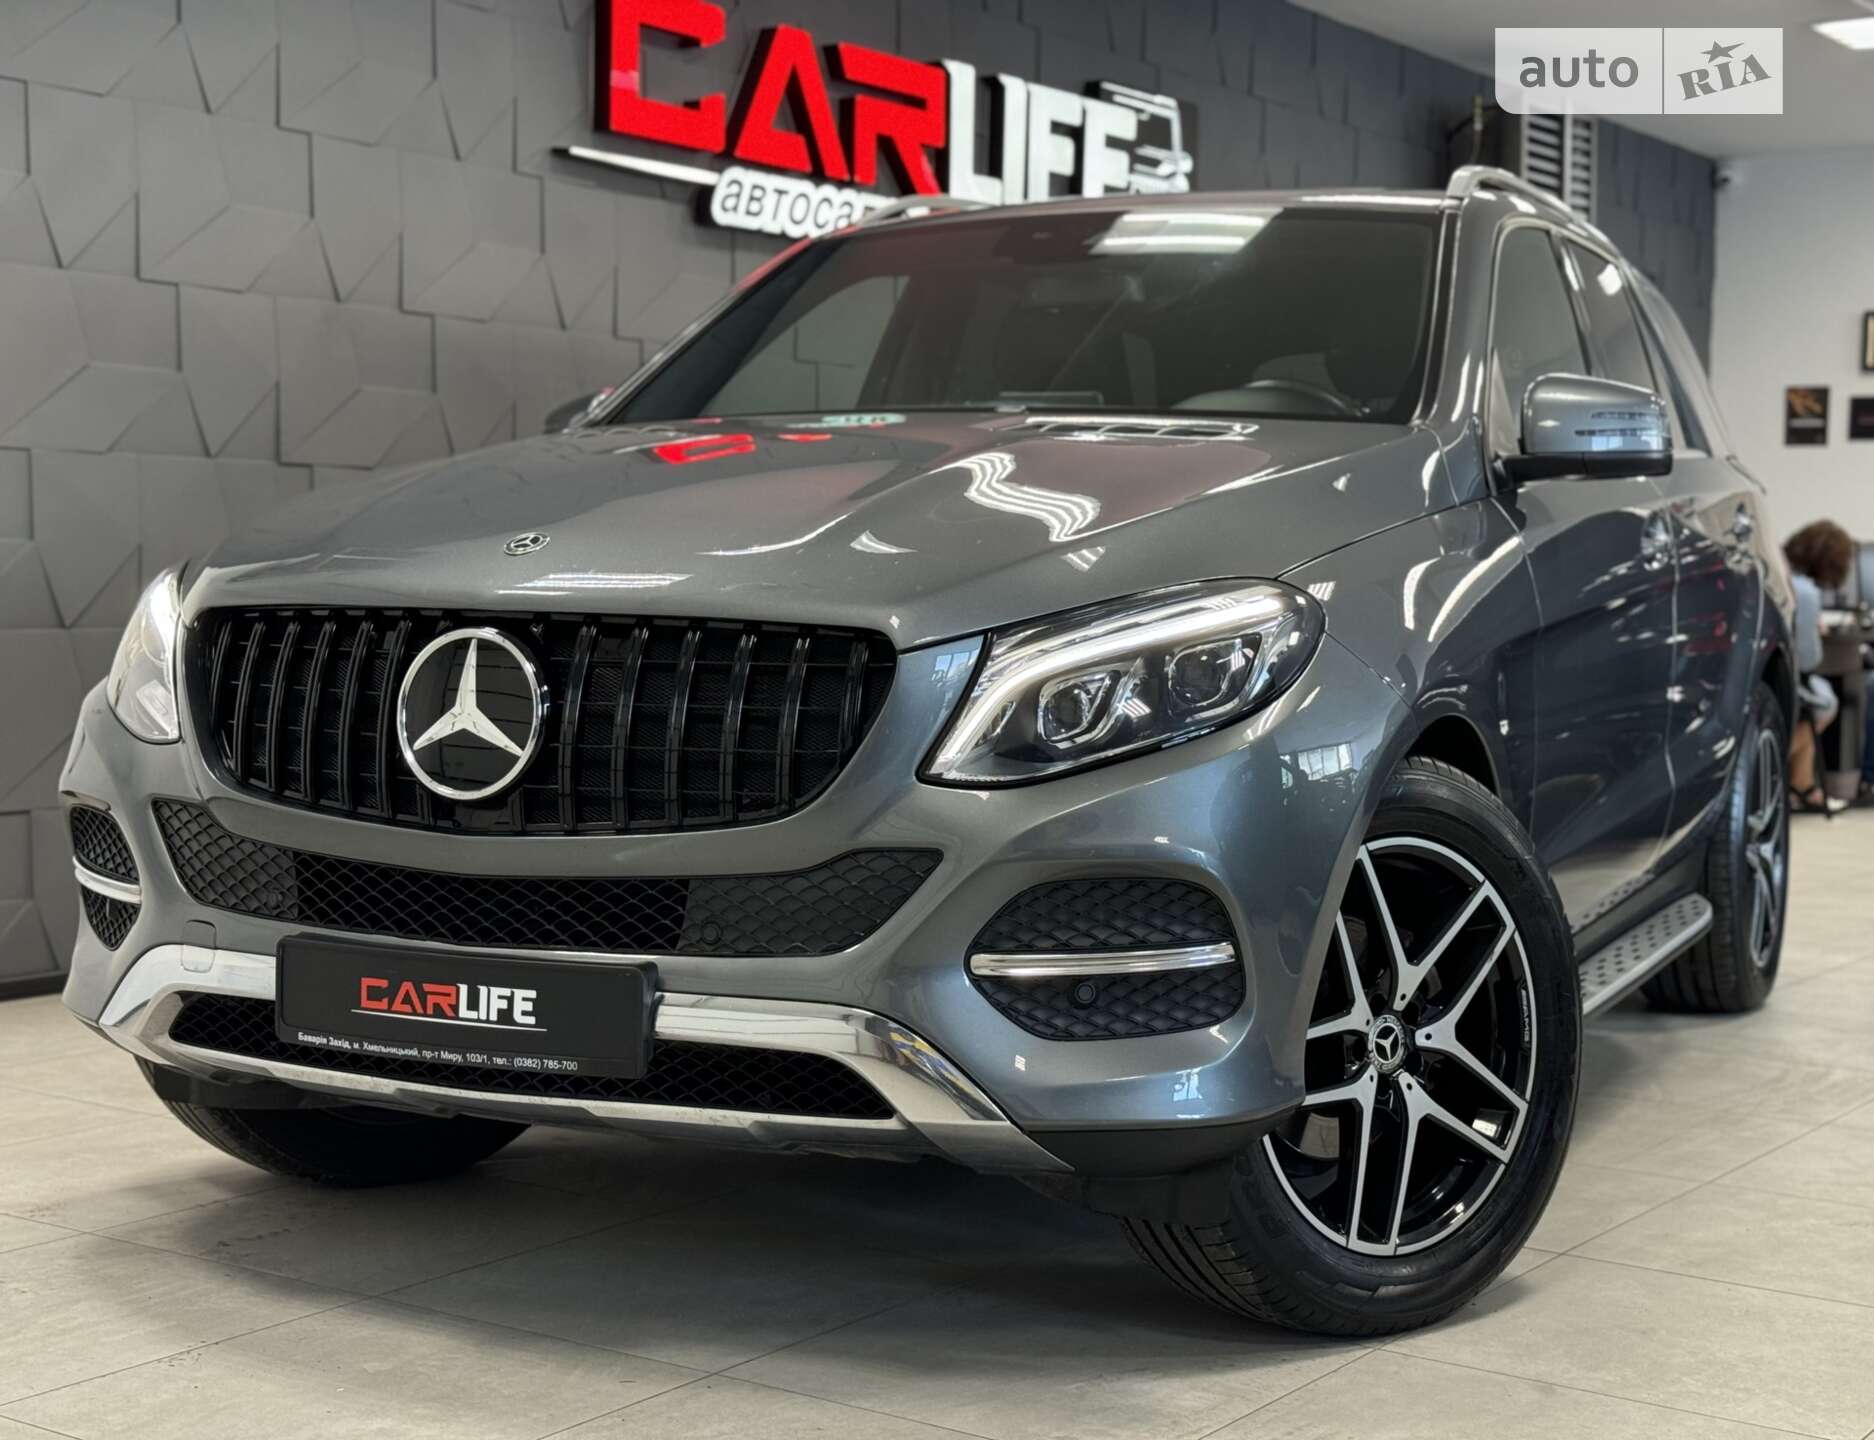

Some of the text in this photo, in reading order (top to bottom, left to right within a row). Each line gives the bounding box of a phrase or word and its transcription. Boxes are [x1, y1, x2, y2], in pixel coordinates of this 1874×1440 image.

[607, 0, 1139, 205] CARLIFE
[720, 179, 878, 230] автоса
[360, 976, 537, 1025] CARLIFE
[513, 1057, 542, 1069] (0382)
[543, 1059, 578, 1071] 785-700
